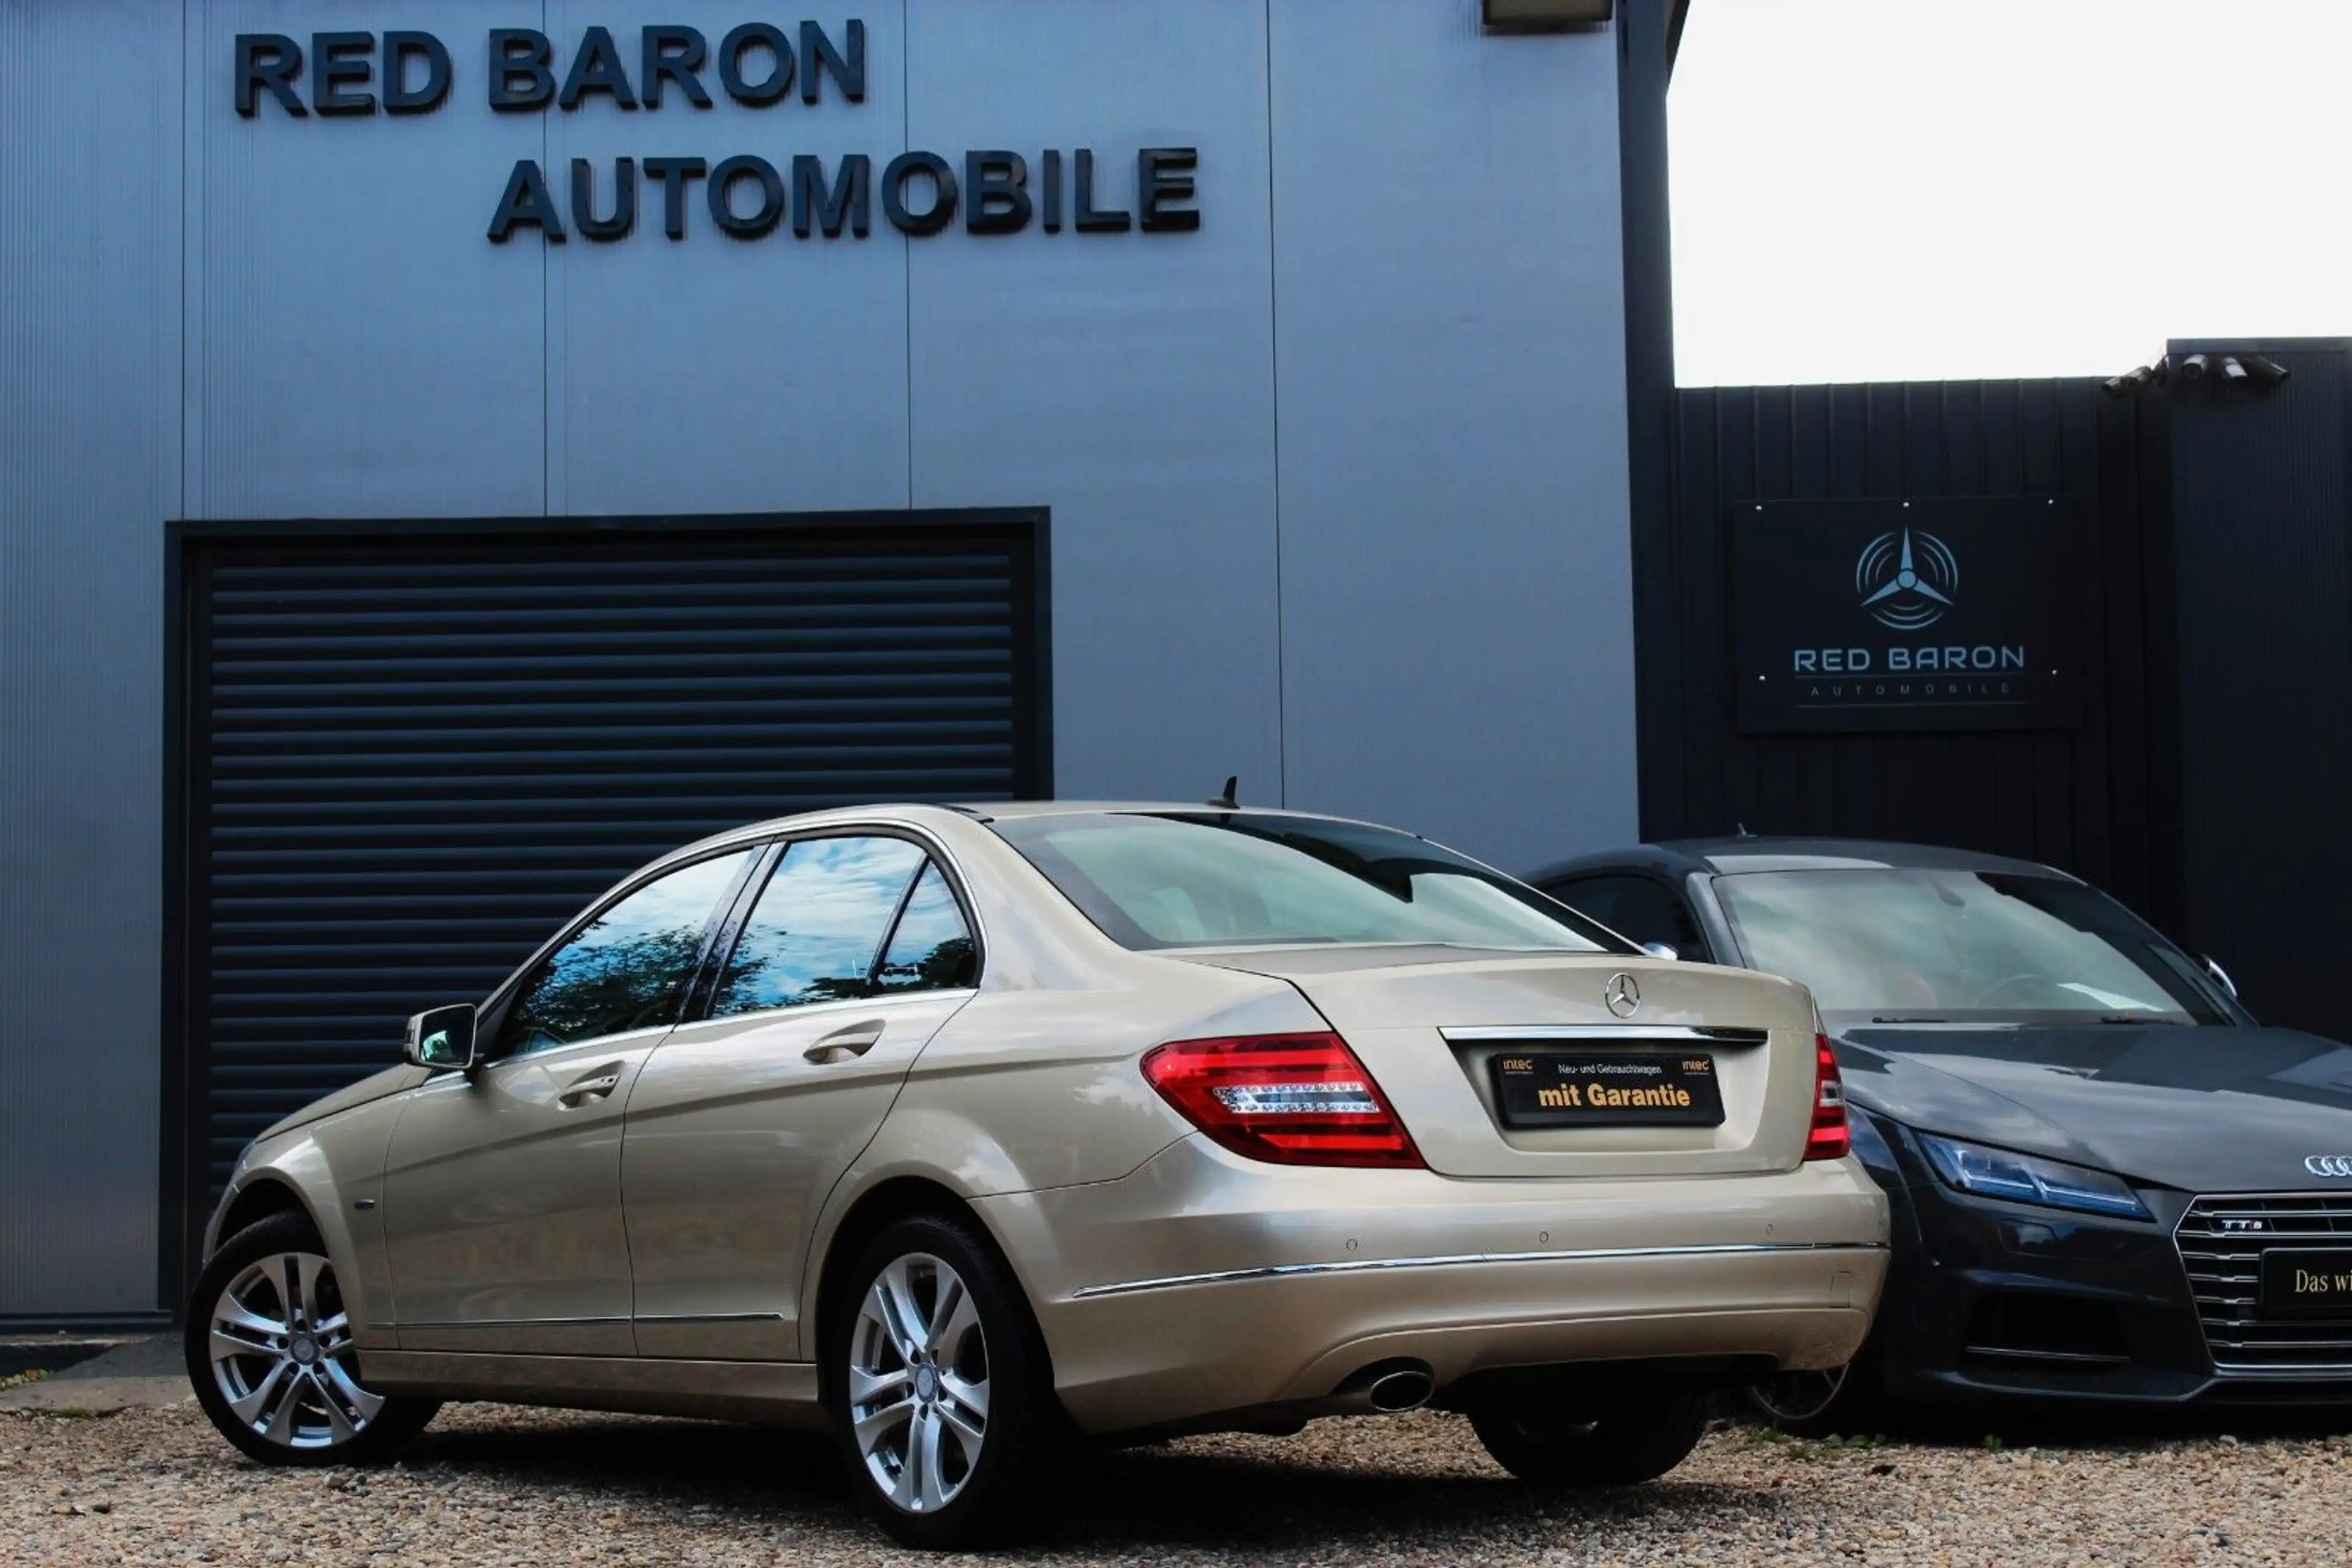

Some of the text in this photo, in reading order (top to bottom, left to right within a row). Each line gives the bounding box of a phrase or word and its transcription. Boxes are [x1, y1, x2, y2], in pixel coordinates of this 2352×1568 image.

[235, 19, 865, 116] RED BARON
[487, 147, 1201, 243] AUTOMOBILE
[1794, 645, 2024, 671] RED BARON
[1810, 682, 2011, 697] AUTOMOBILE
[1558, 1063, 1578, 1074] Neu-
[1580, 1064, 1596, 1074] und
[1538, 1082, 1691, 1107] mit Garantie
[2294, 1269, 2328, 1292] Das
